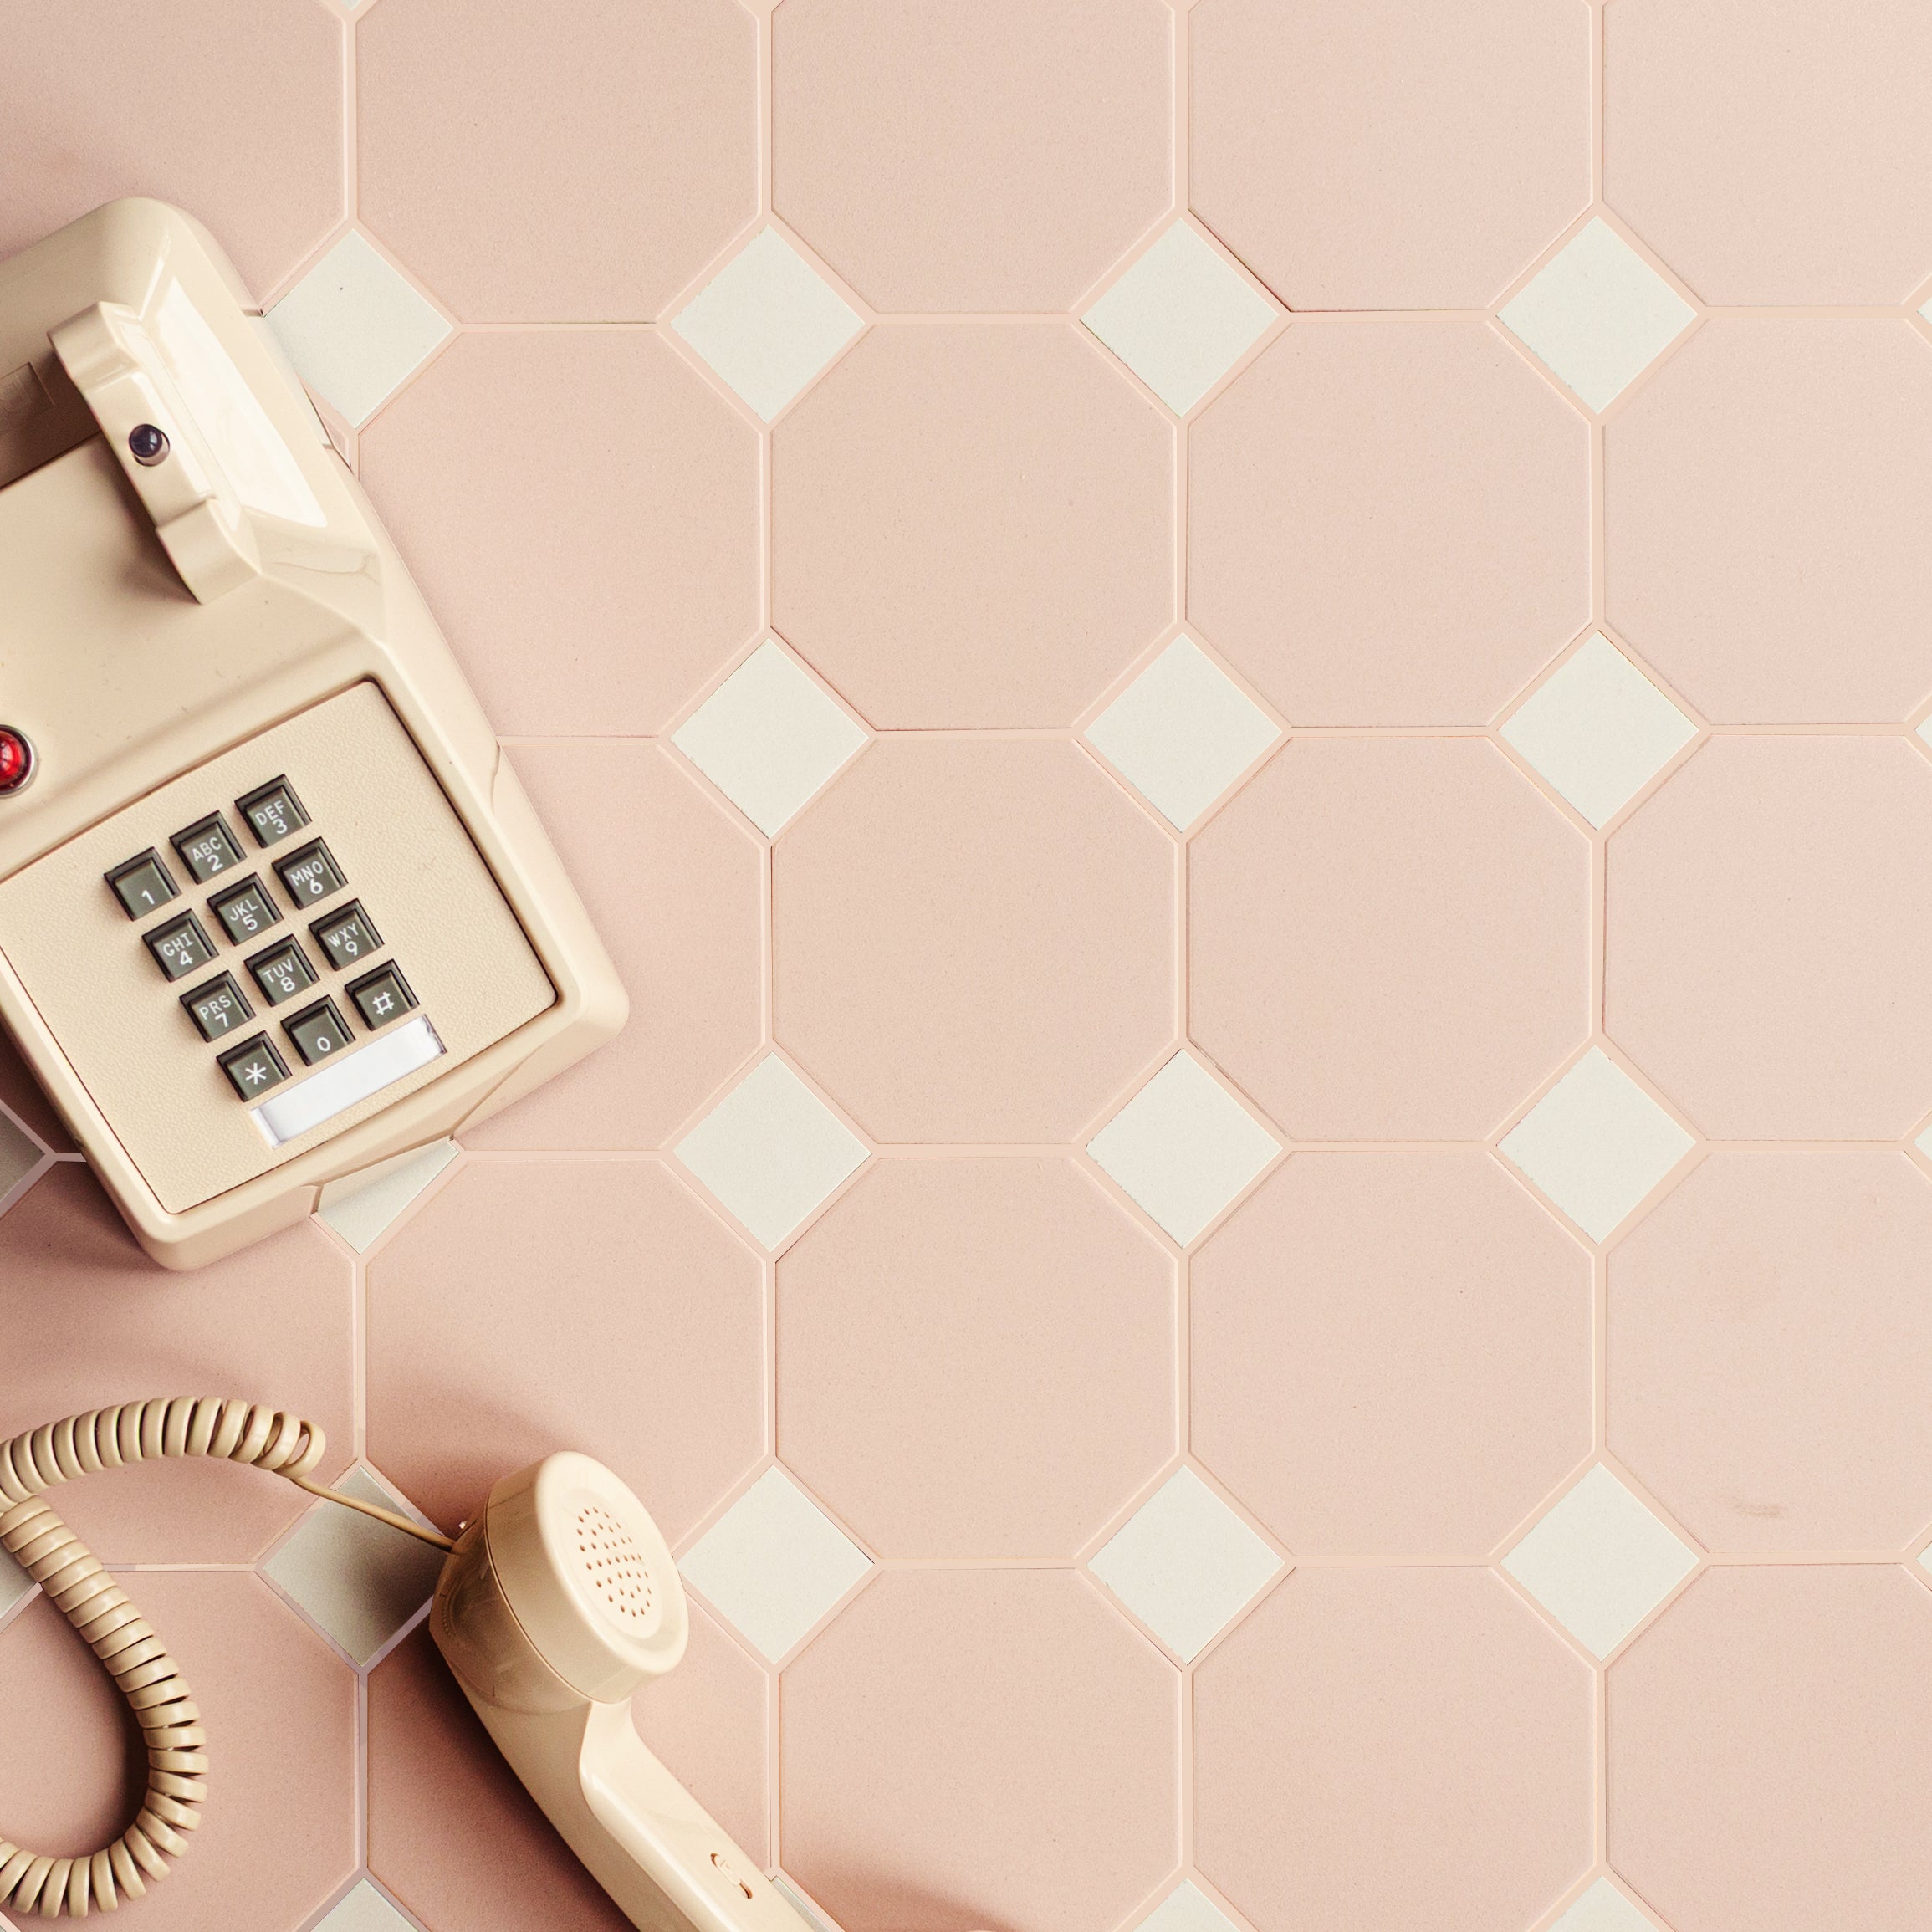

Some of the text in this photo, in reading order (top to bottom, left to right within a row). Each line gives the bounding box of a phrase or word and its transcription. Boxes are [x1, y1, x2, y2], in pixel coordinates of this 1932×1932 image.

[254, 800, 285, 827] DEF
[271, 816, 288, 835] 3
[191, 836, 222, 861] ABC
[206, 854, 224, 872] 2
[290, 860, 324, 887] MNO
[309, 878, 324, 895] 6
[141, 889, 156, 906] 1
[229, 899, 258, 923] JKL
[241, 913, 258, 931] 5
[162, 933, 194, 957] GHI
[327, 923, 360, 948] WXY
[179, 949, 193, 966] 4
[345, 940, 359, 957] 9
[263, 958, 294, 984] TUV
[280, 975, 296, 994] 8
[199, 994, 232, 1020] PRS
[213, 1011, 229, 1029] 7
